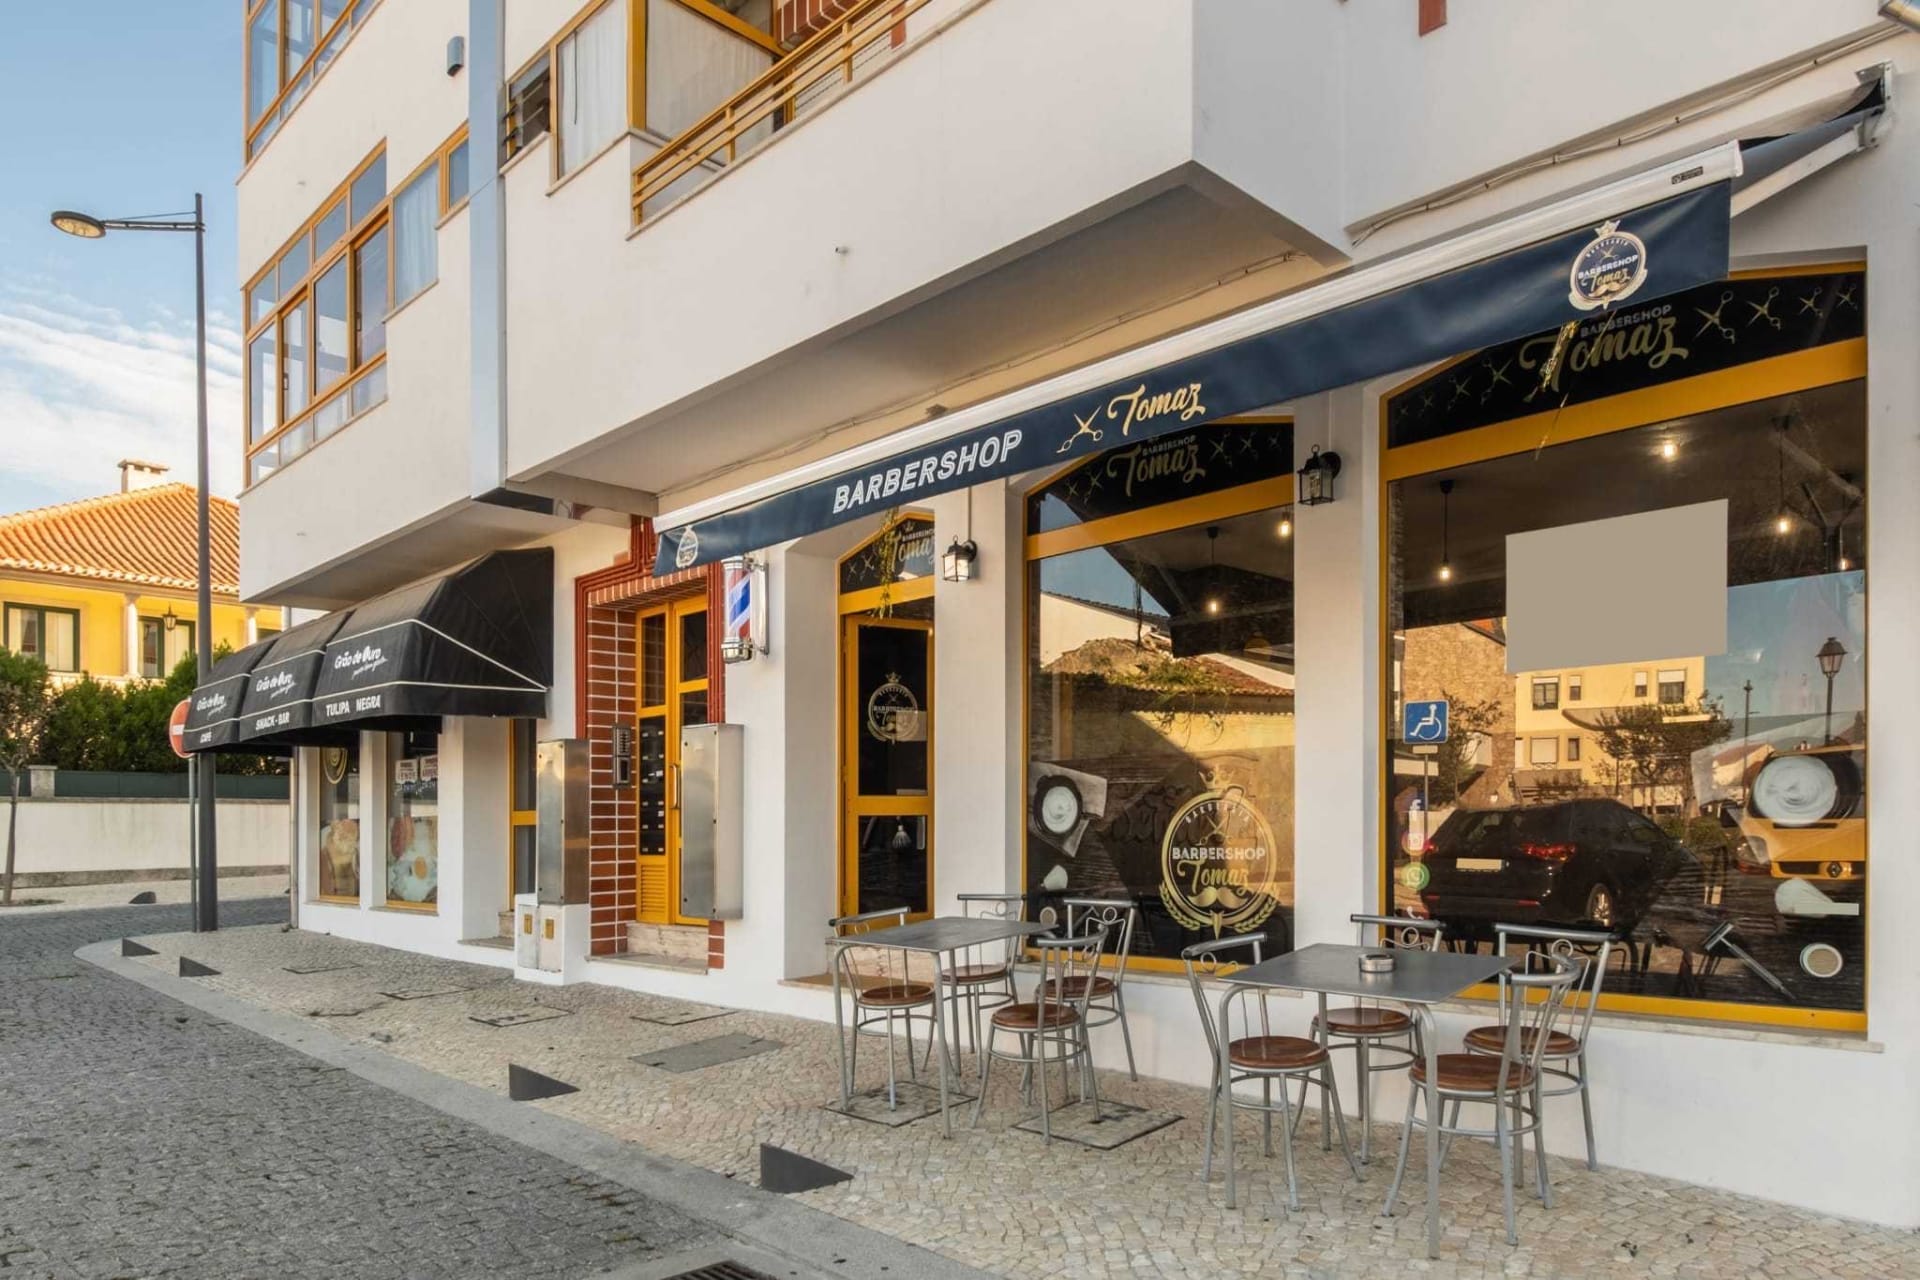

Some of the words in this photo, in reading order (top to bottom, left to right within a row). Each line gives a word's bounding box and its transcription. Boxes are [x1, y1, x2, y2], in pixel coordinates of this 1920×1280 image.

[1578, 254, 1639, 280] BARBERSHOP
[1580, 267, 1632, 292] Tomaz
[1580, 304, 1673, 338] BARBERSHOP
[1519, 316, 1690, 393] Tomaz
[832, 429, 1023, 514] BARBERSHOP
[1107, 383, 1206, 437] Tomaz
[1106, 444, 1206, 497] Tomaz
[326, 700, 350, 717] TULIPA
[356, 694, 381, 712] NEGRA
[1172, 847, 1266, 860] BARBERSHOP
[1176, 857, 1254, 896] Tomaz
